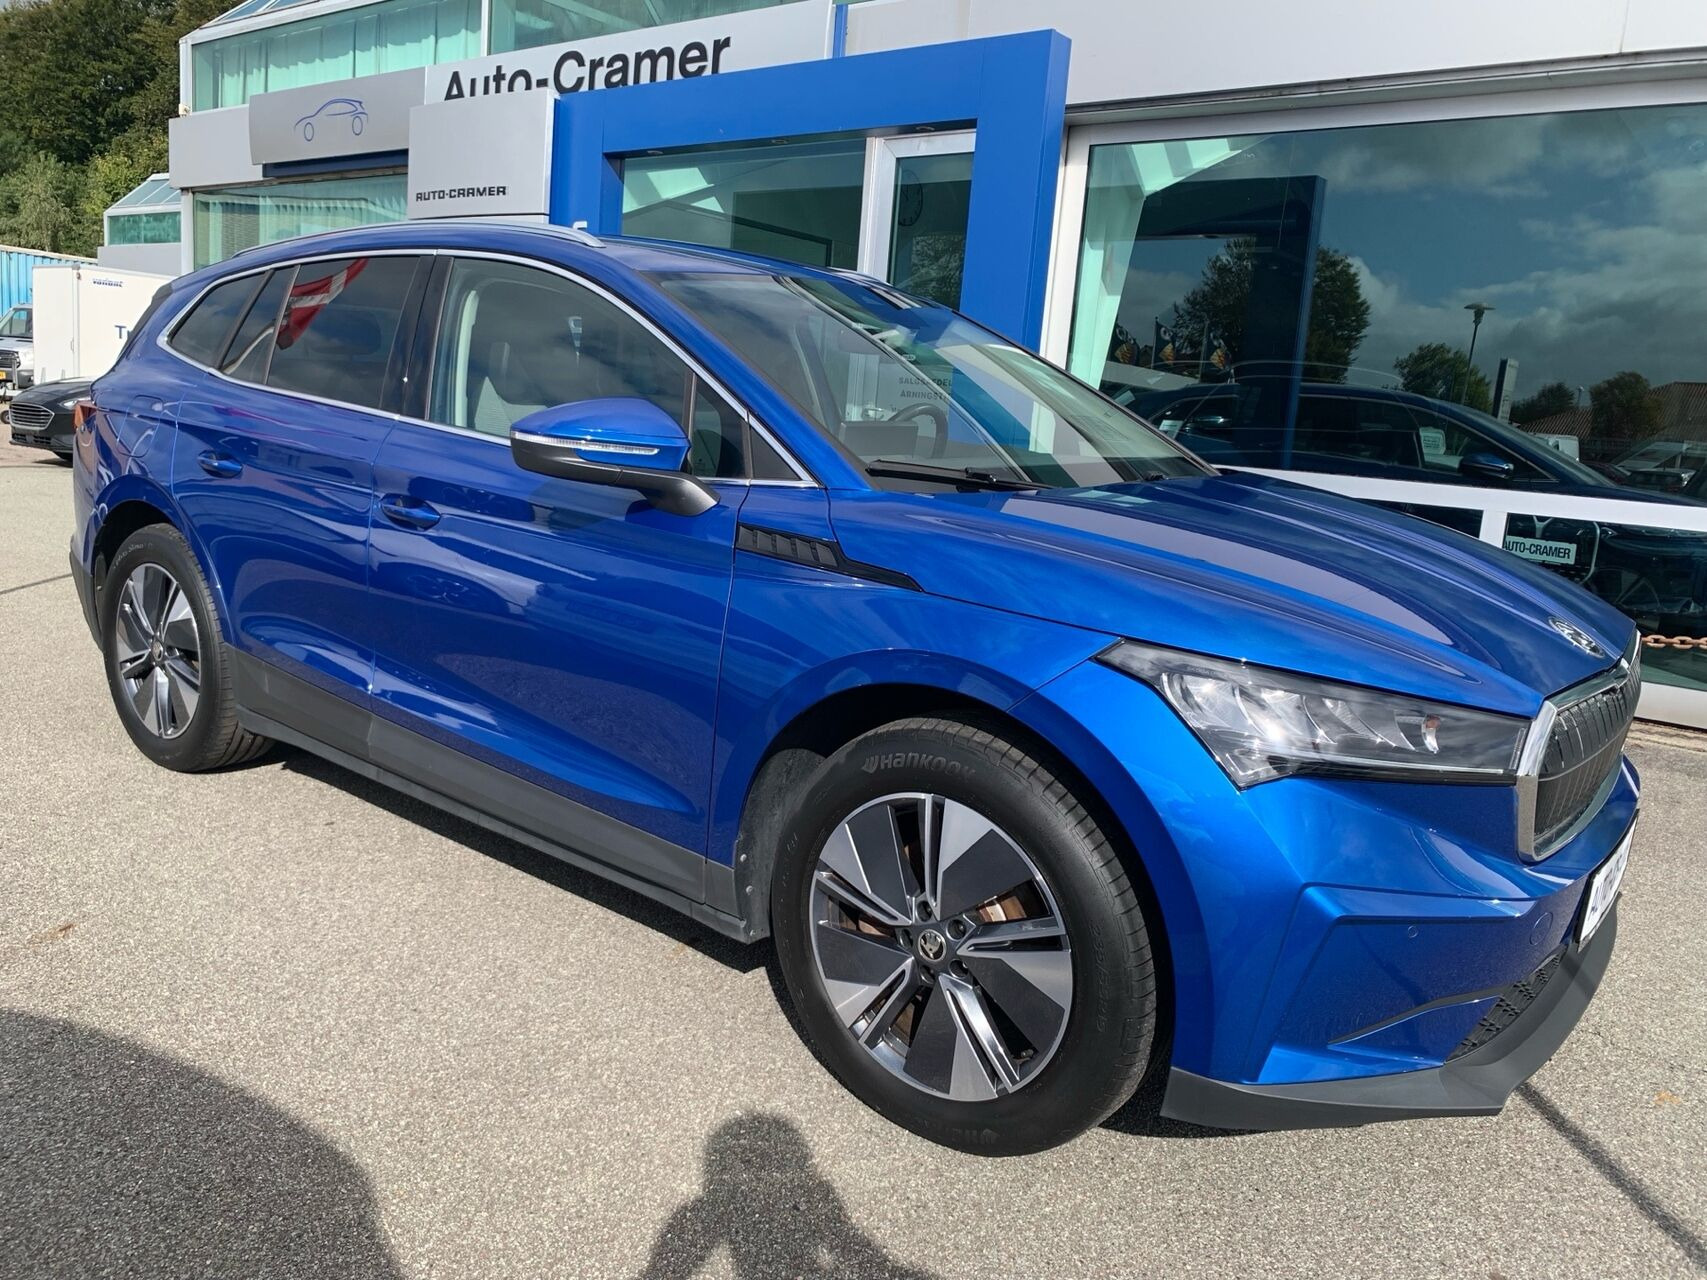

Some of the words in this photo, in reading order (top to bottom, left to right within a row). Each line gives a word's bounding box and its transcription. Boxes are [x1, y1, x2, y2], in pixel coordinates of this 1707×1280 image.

[444, 36, 731, 101] Auto-Cramer
[415, 185, 507, 202] AUTO-CRAMER
[1504, 540, 1572, 560] AUTO-CRAMER
